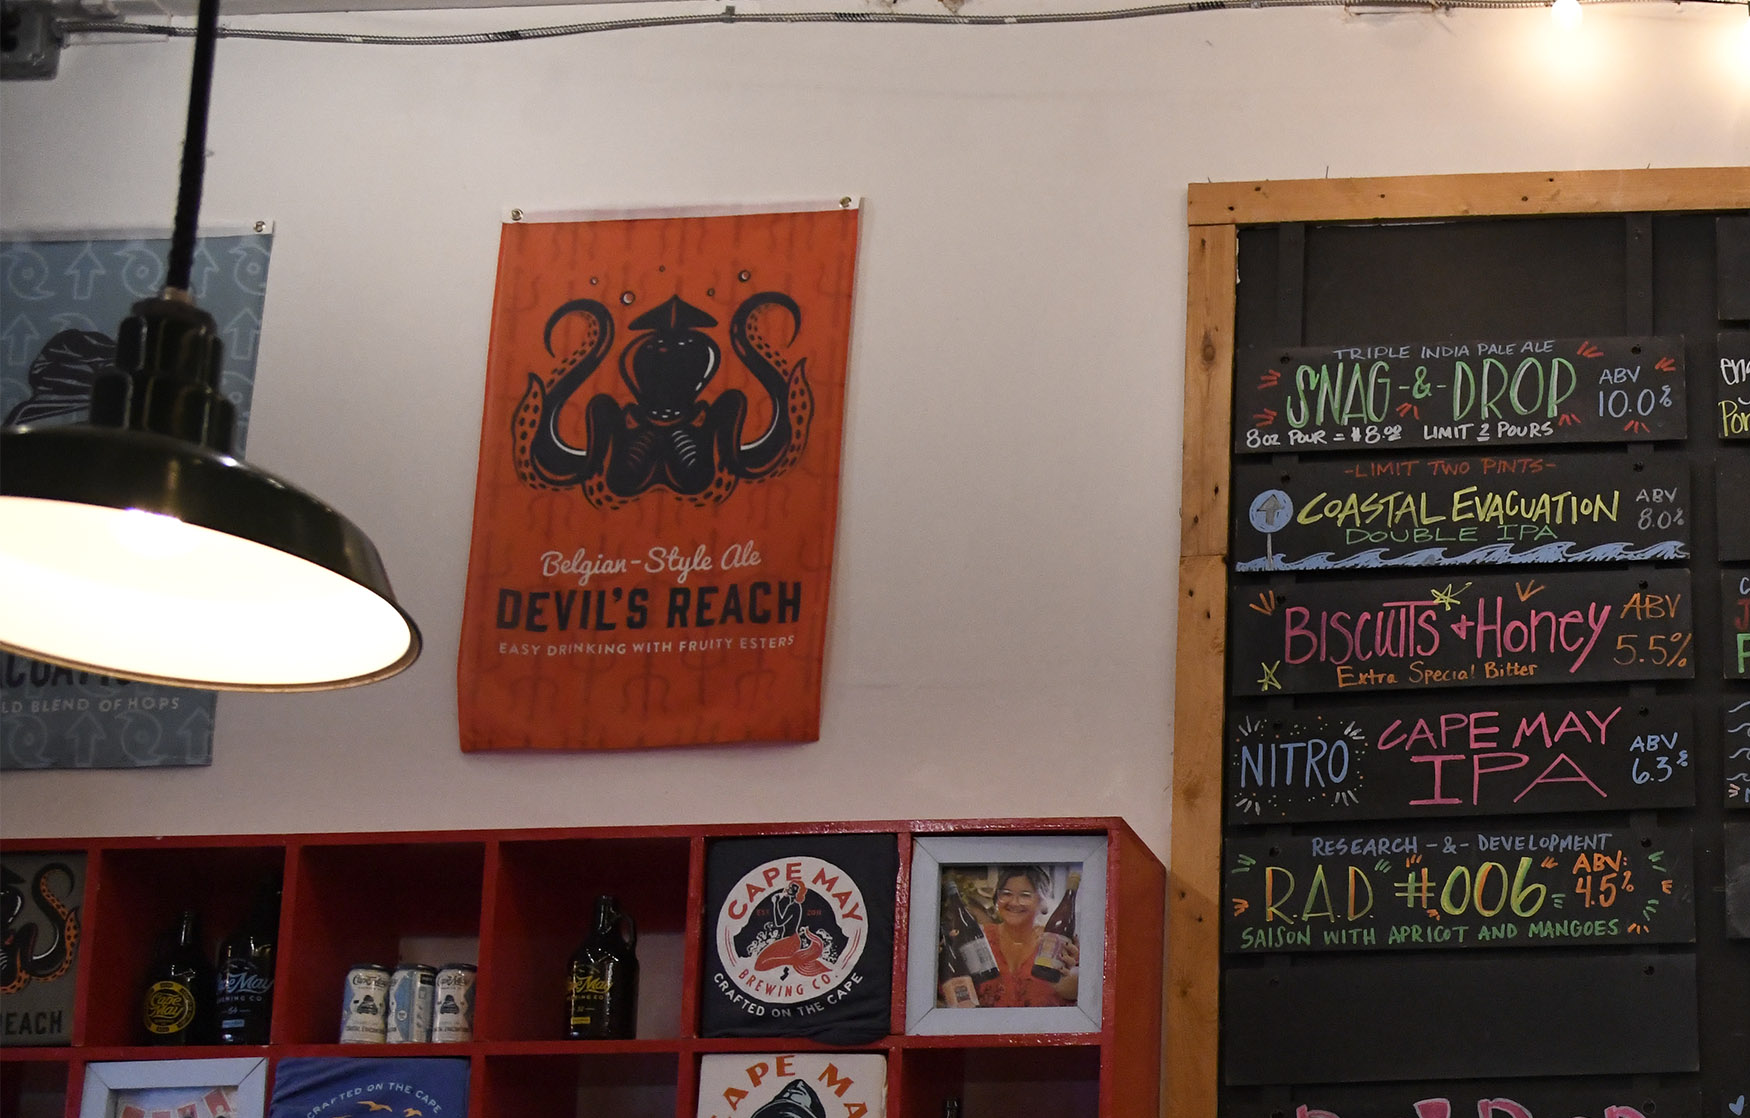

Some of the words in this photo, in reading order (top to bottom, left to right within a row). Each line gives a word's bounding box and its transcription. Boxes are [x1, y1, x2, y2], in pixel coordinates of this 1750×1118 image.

[1333, 344, 1410, 360] TRIPLE
[1421, 344, 1469, 358] INDIA
[1477, 343, 1515, 357] PALE
[1521, 340, 1555, 354] ALE
[1600, 366, 1640, 385] ABV
[1287, 361, 1390, 427] SNAG
[1453, 358, 1576, 422] DROP
[1598, 386, 1672, 418] 10.0%
[1636, 488, 1677, 503] ABV
[495, 586, 649, 633] DEVIL'S
[667, 580, 802, 629] REACH
[1620, 594, 1681, 620] ABV
[500, 641, 541, 656] EASY
[547, 639, 627, 656] DRINKING
[633, 639, 672, 654] WITH
[679, 637, 734, 652] FRUITY
[740, 634, 795, 650] ESTERS
[1614, 633, 1692, 669] 5.5%
[32, 699, 89, 712] BLEND
[100, 699, 121, 712] OF
[128, 698, 179, 711] HOPS
[1377, 712, 1500, 752] CAPE
[1512, 707, 1622, 749] MAY
[1629, 732, 1679, 753] ABV
[1240, 739, 1350, 789] NITRO
[1409, 752, 1608, 806] IPA
[728, 862, 804, 920] CAPE
[812, 867, 864, 921] MAY
[1574, 869, 1635, 909] 4.5%
[713, 972, 765, 1017] CRAFTED
[771, 1008, 792, 1018] ON
[797, 1002, 825, 1017] THE
[827, 972, 864, 1005] CAPE
[739, 968, 804, 997] BREWING
[367, 1083, 383, 1092] ON
[389, 1082, 413, 1094] THE
[415, 1090, 442, 1114] CAPE
